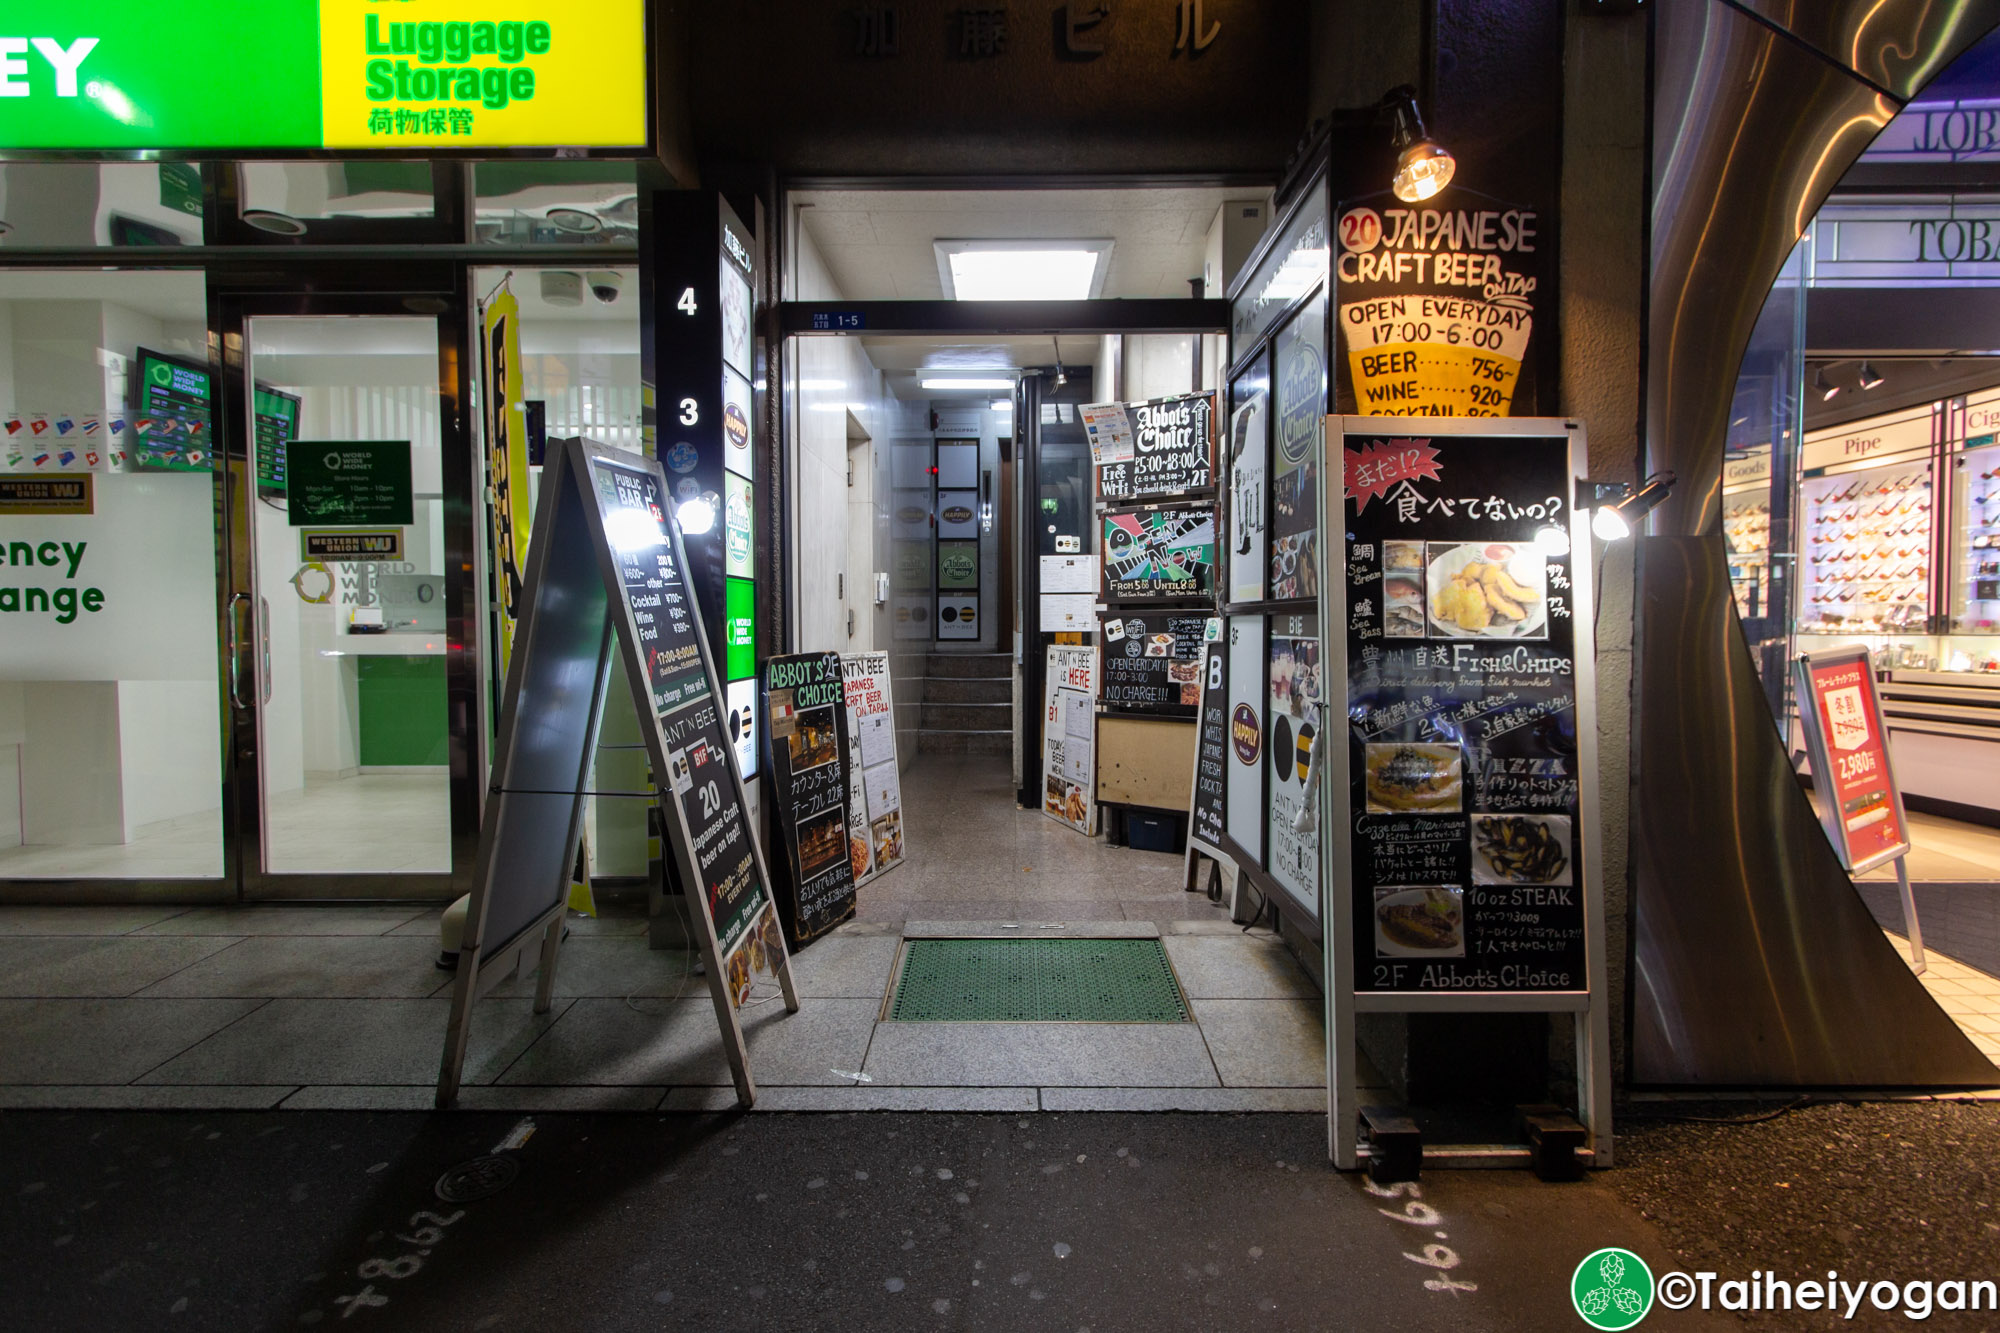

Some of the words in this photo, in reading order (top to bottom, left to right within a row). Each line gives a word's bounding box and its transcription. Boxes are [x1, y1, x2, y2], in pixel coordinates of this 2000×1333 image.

[365, 14, 551, 62] Luggage
[365, 60, 535, 109] Storage
[368, 109, 474, 136] 荷物保管
[1342, 214, 1378, 247] 20
[1381, 209, 1537, 252] JAPANESE
[1910, 219, 2000, 262] TOB
[1338, 250, 1432, 284] CRAFT
[1434, 252, 1502, 287] BEER
[1504, 272, 1536, 295] TAP
[677, 287, 697, 316] 4
[838, 315, 858, 326] 1-5
[1349, 298, 1406, 325] OPEN
[1422, 299, 1528, 331] EVERYDAY
[1361, 351, 1418, 378] BEER
[173, 367, 205, 383] WORLD
[173, 375, 196, 387] WIDE
[172, 382, 204, 396] MONEY
[1366, 381, 1419, 403] WINE
[679, 398, 699, 425] 3
[1137, 401, 1191, 430] Abbot's
[1137, 426, 1193, 453] Choice
[1844, 436, 1883, 456] Pipe
[1102, 465, 1126, 480] Free
[1354, 449, 1421, 487] まだ!?
[1728, 460, 1766, 479] Goods
[614, 473, 641, 490] PUBLIC
[1191, 469, 1210, 487] 2F
[53, 484, 80, 497] WU
[617, 486, 644, 508] BAR
[1385, 481, 1563, 523] 食べてないの?
[944, 510, 971, 518] HAPPILY
[1163, 511, 1177, 520] 2F
[1195, 511, 1214, 519] Choice
[311, 537, 359, 545] WESTERN
[364, 537, 392, 551] WU
[1109, 521, 1177, 558] OPEN
[0, 541, 88, 579] ncy
[1147, 545, 1203, 573] NOW
[1347, 563, 1368, 577] Sea
[1353, 571, 1381, 586] Bream
[646, 577, 663, 589] other
[630, 593, 662, 609] Cocktail
[634, 611, 655, 625] Wine
[735, 618, 751, 628] WORLD
[1350, 618, 1371, 630] Sea
[639, 626, 658, 641] Food
[735, 627, 748, 636] WIDE
[735, 635, 752, 645] MONEY
[1231, 627, 1239, 646] 3F
[1358, 627, 1382, 640] Bass
[867, 658, 884, 674] BEE
[1058, 652, 1071, 668] ANT
[1077, 652, 1090, 668] BEE
[1106, 658, 1128, 671] OPEN
[770, 660, 824, 689] ABBOT'S
[822, 654, 839, 678] 2F
[1368, 674, 1408, 689] Direct
[1512, 675, 1552, 688] market
[654, 694, 664, 706] No
[663, 687, 682, 703] charge
[683, 681, 697, 695] Free
[797, 681, 843, 707] CHOICE
[865, 690, 882, 704] BEER
[1106, 685, 1120, 700] NO
[855, 705, 867, 718] ON
[1048, 706, 1058, 723] B1
[664, 720, 686, 745] ANT
[694, 705, 717, 730] BEE
[1233, 720, 1259, 748] HAPPILY
[693, 748, 708, 767] B1F
[1202, 761, 1221, 776] FRESH
[698, 779, 721, 820] 20
[1275, 791, 1290, 811] ANT
[1196, 806, 1208, 820] No
[1272, 807, 1288, 830] OPEN
[692, 817, 724, 852] Japanese
[723, 801, 740, 824] Craft
[700, 846, 718, 870] beer
[717, 839, 727, 854] on
[725, 822, 741, 846] tap!!
[1276, 850, 1286, 871] NO
[1287, 860, 1313, 897] CHARGE
[727, 883, 743, 905] EVERY
[741, 871, 751, 889] DAY
[1468, 887, 1487, 906] 10
[1489, 894, 1508, 906] oz
[1510, 888, 1574, 906] STEAK
[718, 938, 727, 952] No
[724, 919, 742, 945] charge
[741, 904, 754, 922] Free
[1373, 965, 1408, 988] 2F
[1419, 965, 1498, 990] Abbot's
